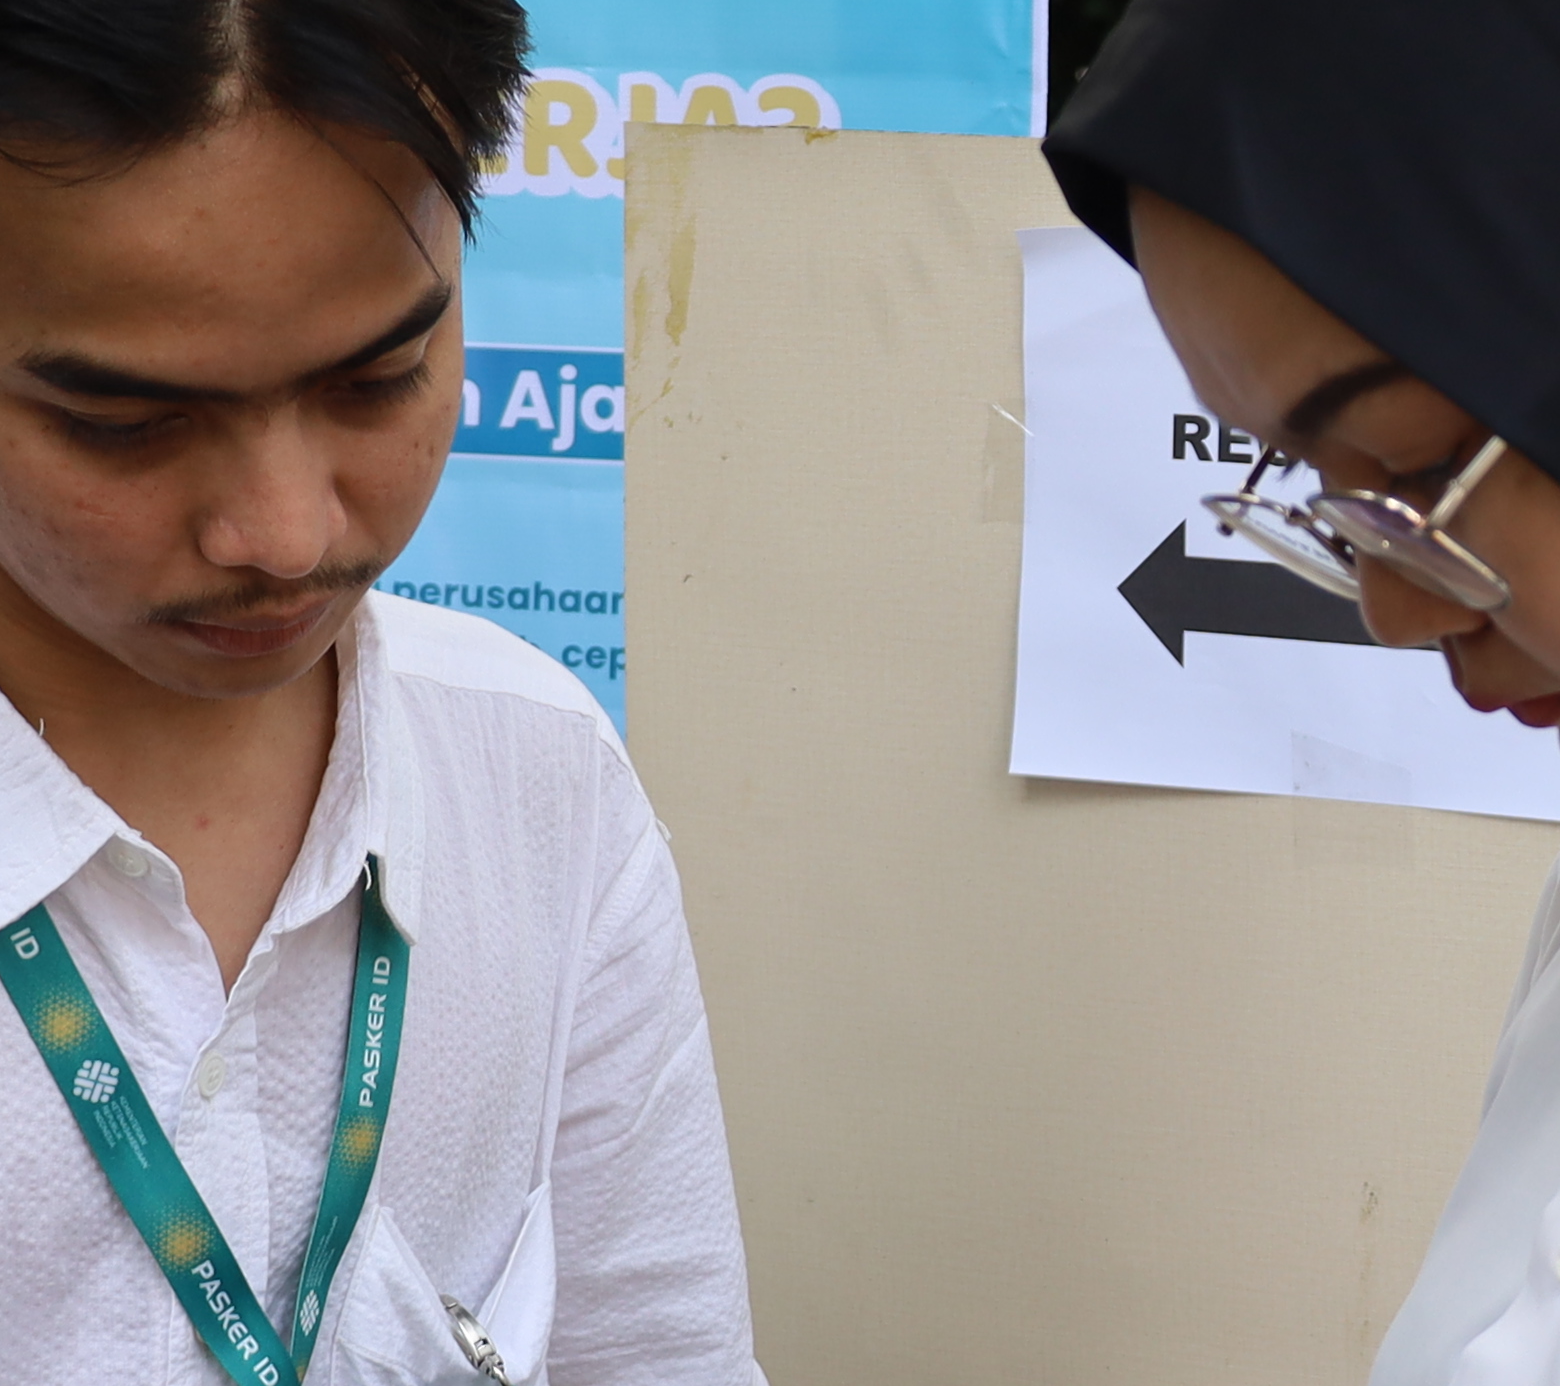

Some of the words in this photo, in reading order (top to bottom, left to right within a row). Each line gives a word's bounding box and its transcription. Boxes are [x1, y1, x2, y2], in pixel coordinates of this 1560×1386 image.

[1172, 413, 1287, 467] RE
[10, 927, 40, 959] ID
[371, 956, 391, 985] ID
[359, 992, 387, 1108] PASKER
[191, 1259, 259, 1361] PASKER
